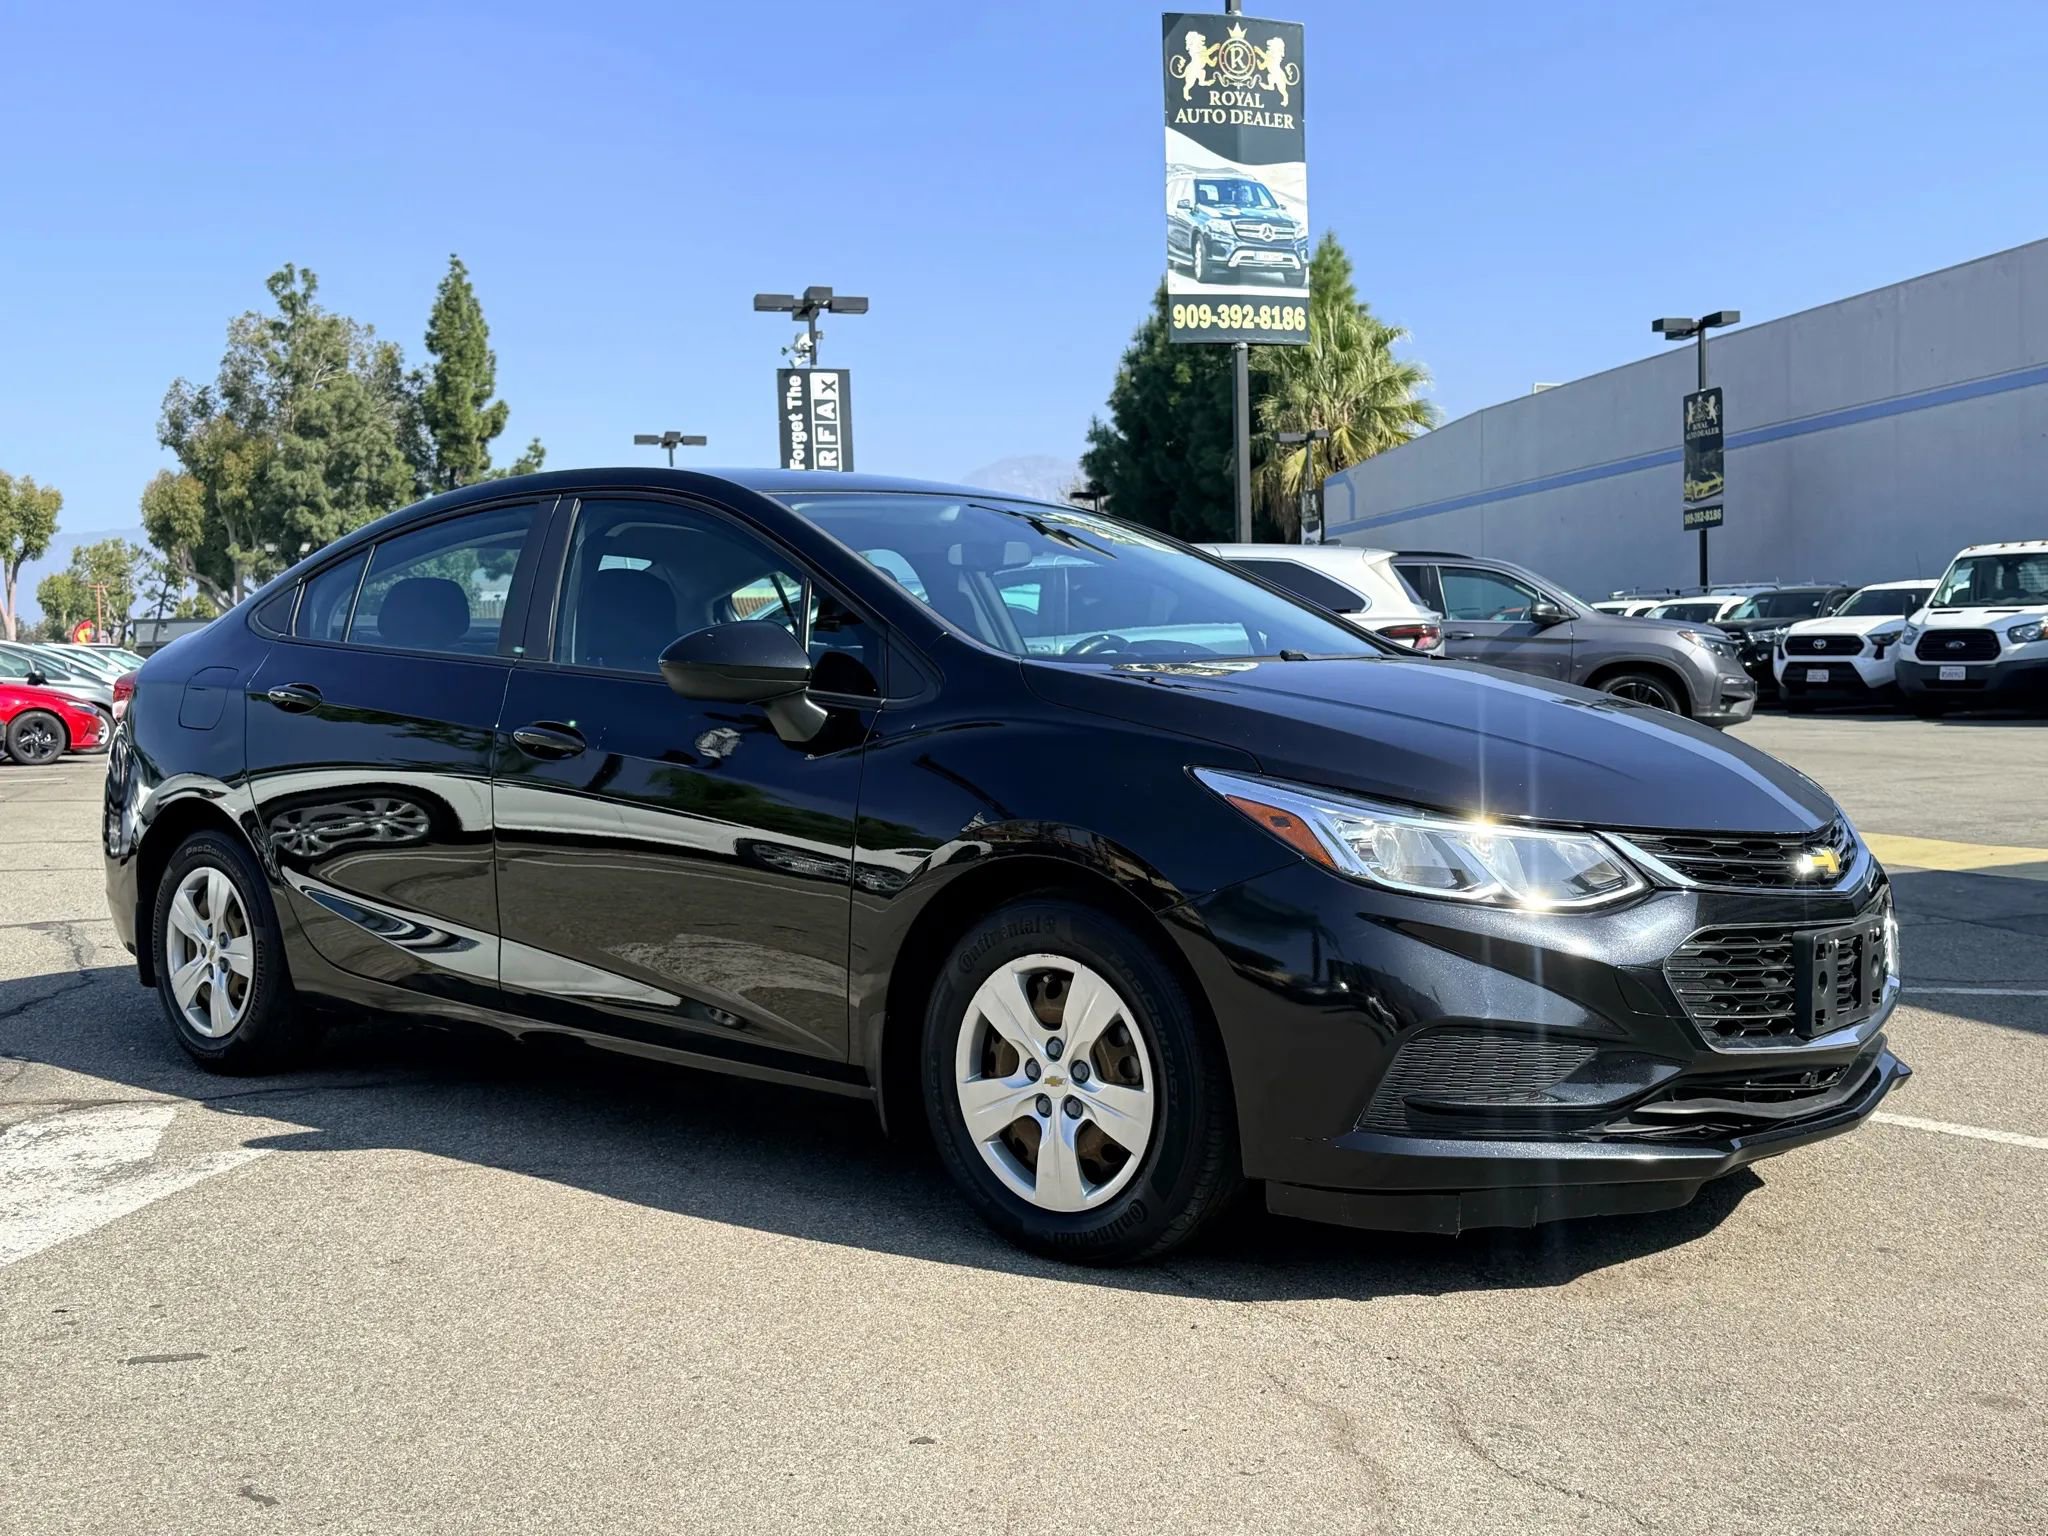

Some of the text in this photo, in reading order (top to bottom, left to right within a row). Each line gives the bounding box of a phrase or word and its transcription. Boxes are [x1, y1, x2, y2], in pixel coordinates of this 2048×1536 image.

[1209, 90, 1265, 109] ROYAL
[1174, 107, 1296, 130] AUTO DEALER
[1172, 303, 1307, 332] 909-392-8186
[786, 375, 808, 470] Forget The
